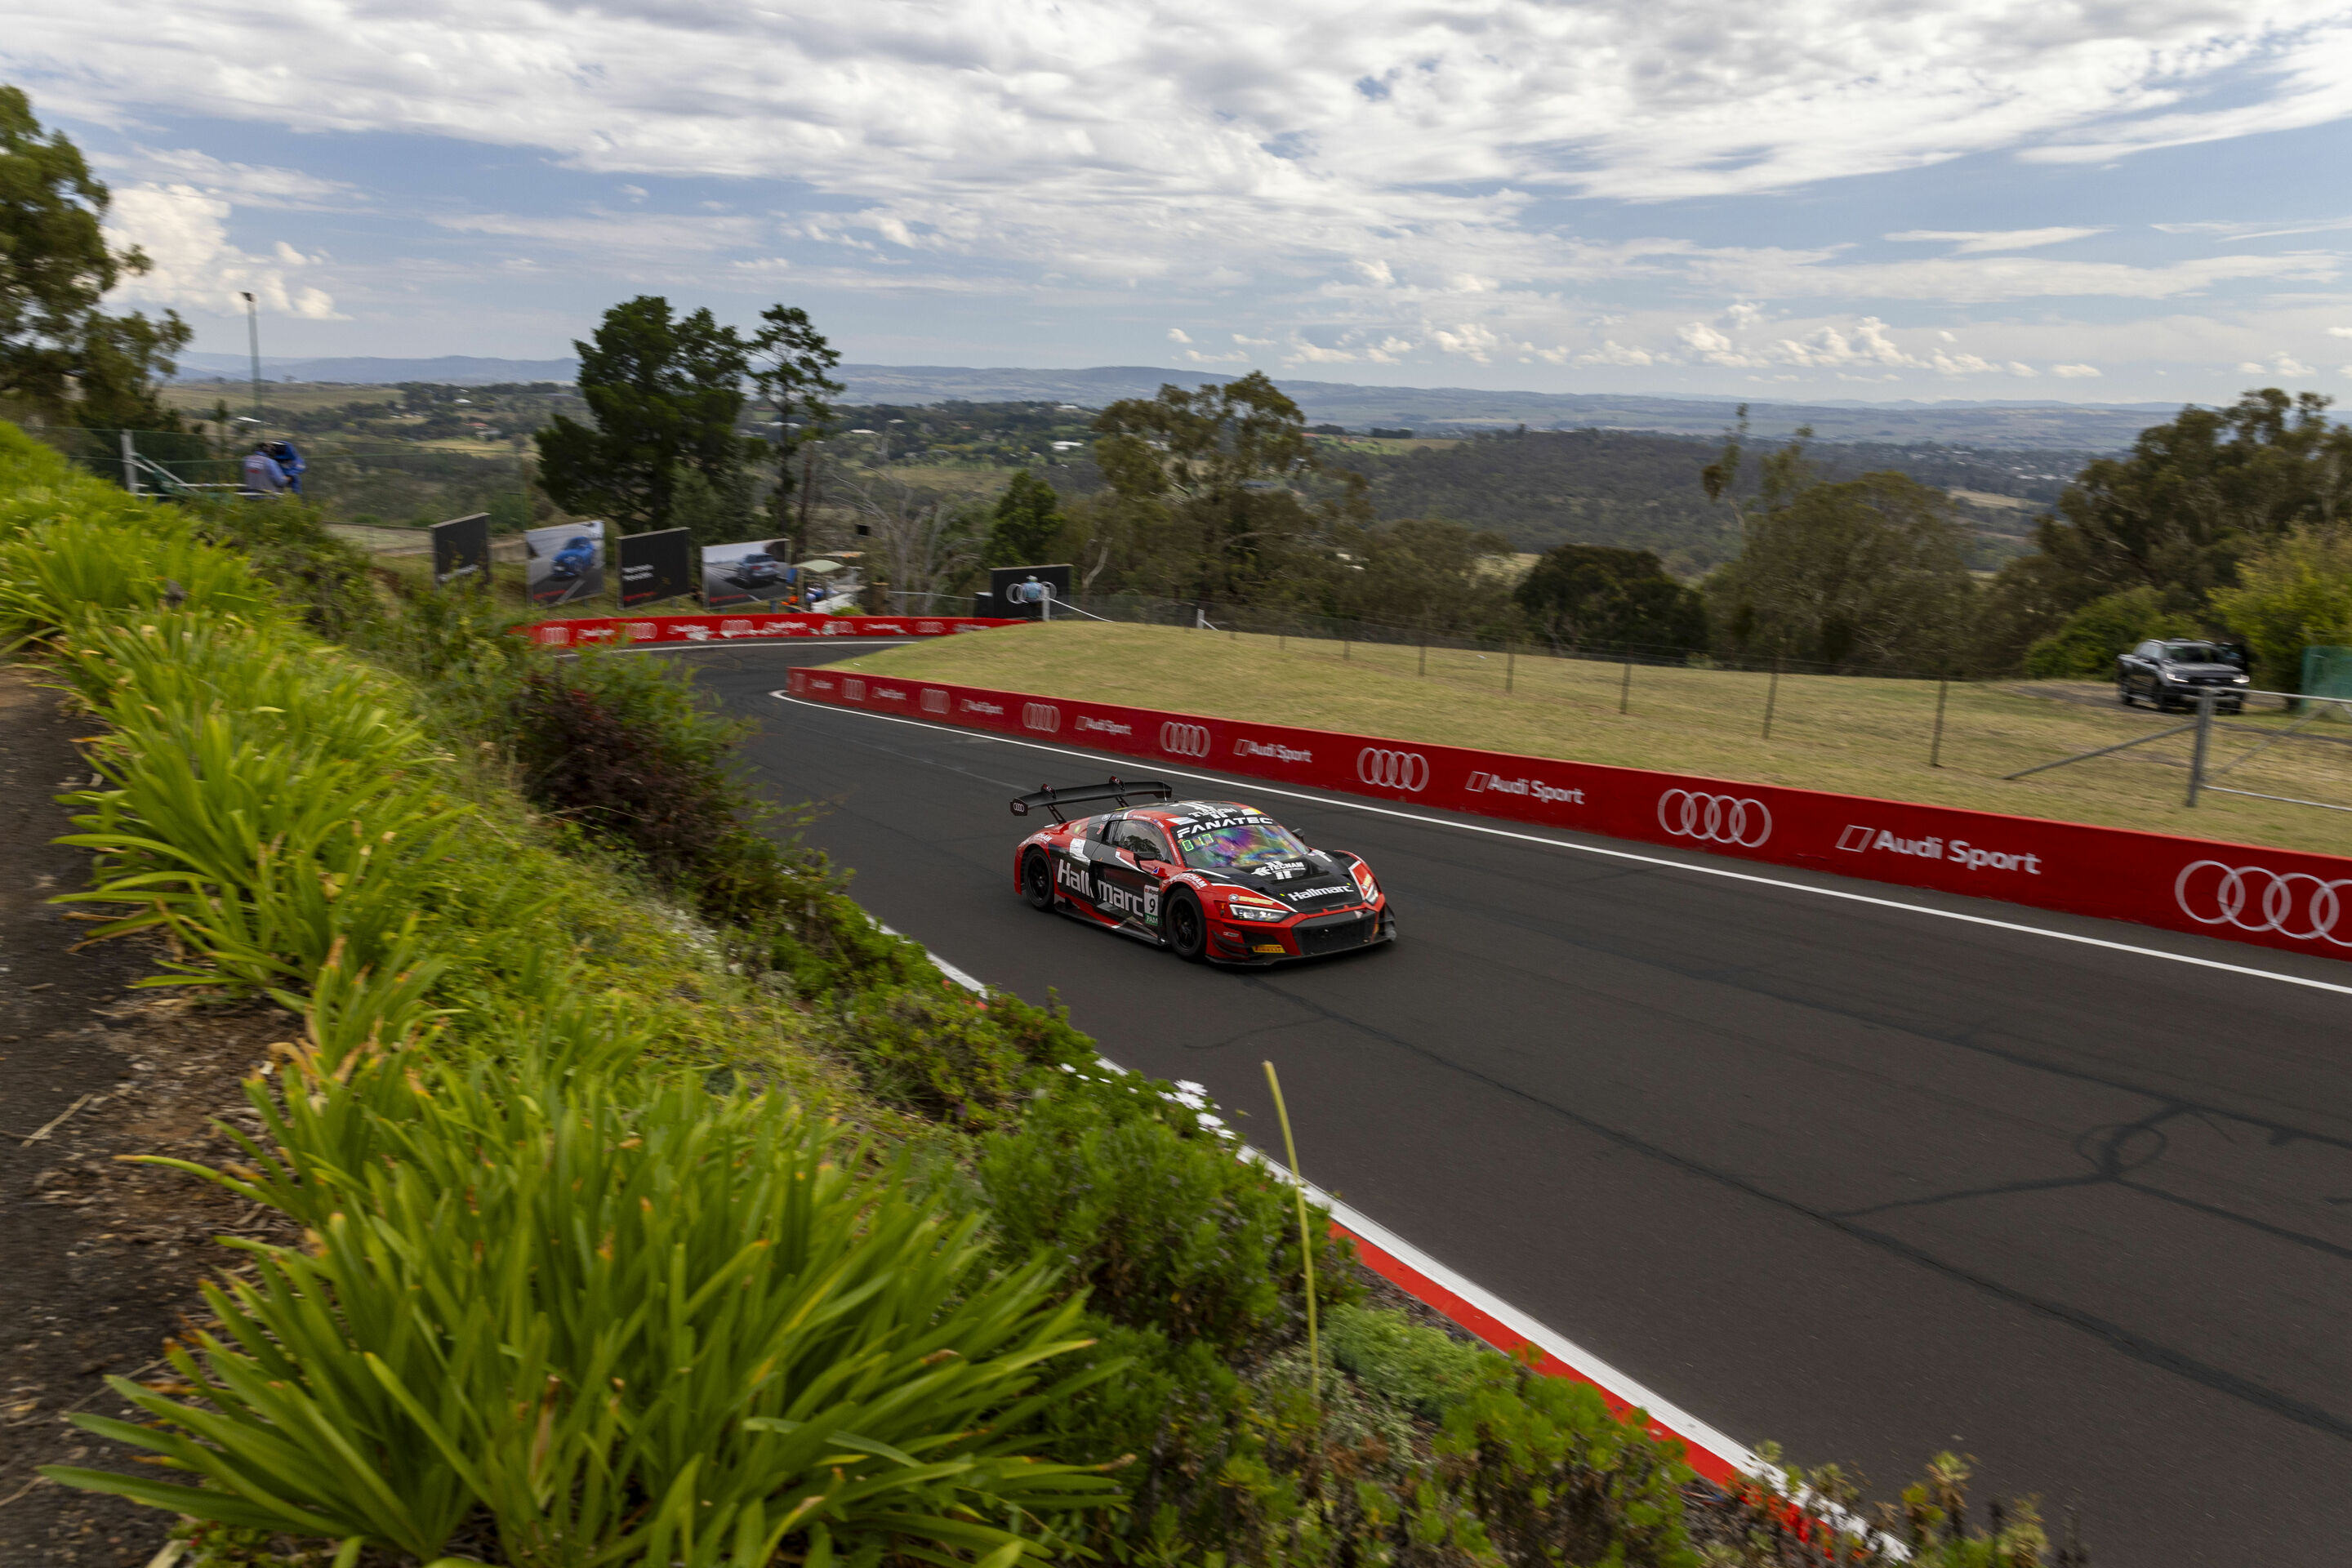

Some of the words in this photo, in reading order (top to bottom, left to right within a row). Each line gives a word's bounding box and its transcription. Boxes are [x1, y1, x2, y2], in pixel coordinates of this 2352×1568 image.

[1247, 741, 1276, 758] Audi
[1276, 744, 1312, 763] Sport
[1486, 774, 1530, 795] Audi
[1530, 780, 1585, 804] Sport
[1177, 817, 1273, 839] FANATEC
[1873, 830, 1943, 859] Audi
[1947, 840, 2041, 875] Sport
[1267, 862, 1304, 871] TECNAM
[1057, 858, 1144, 918] Hallmarc
[1287, 885, 1354, 902] Hallmarc
[1149, 898, 1156, 913] 9
